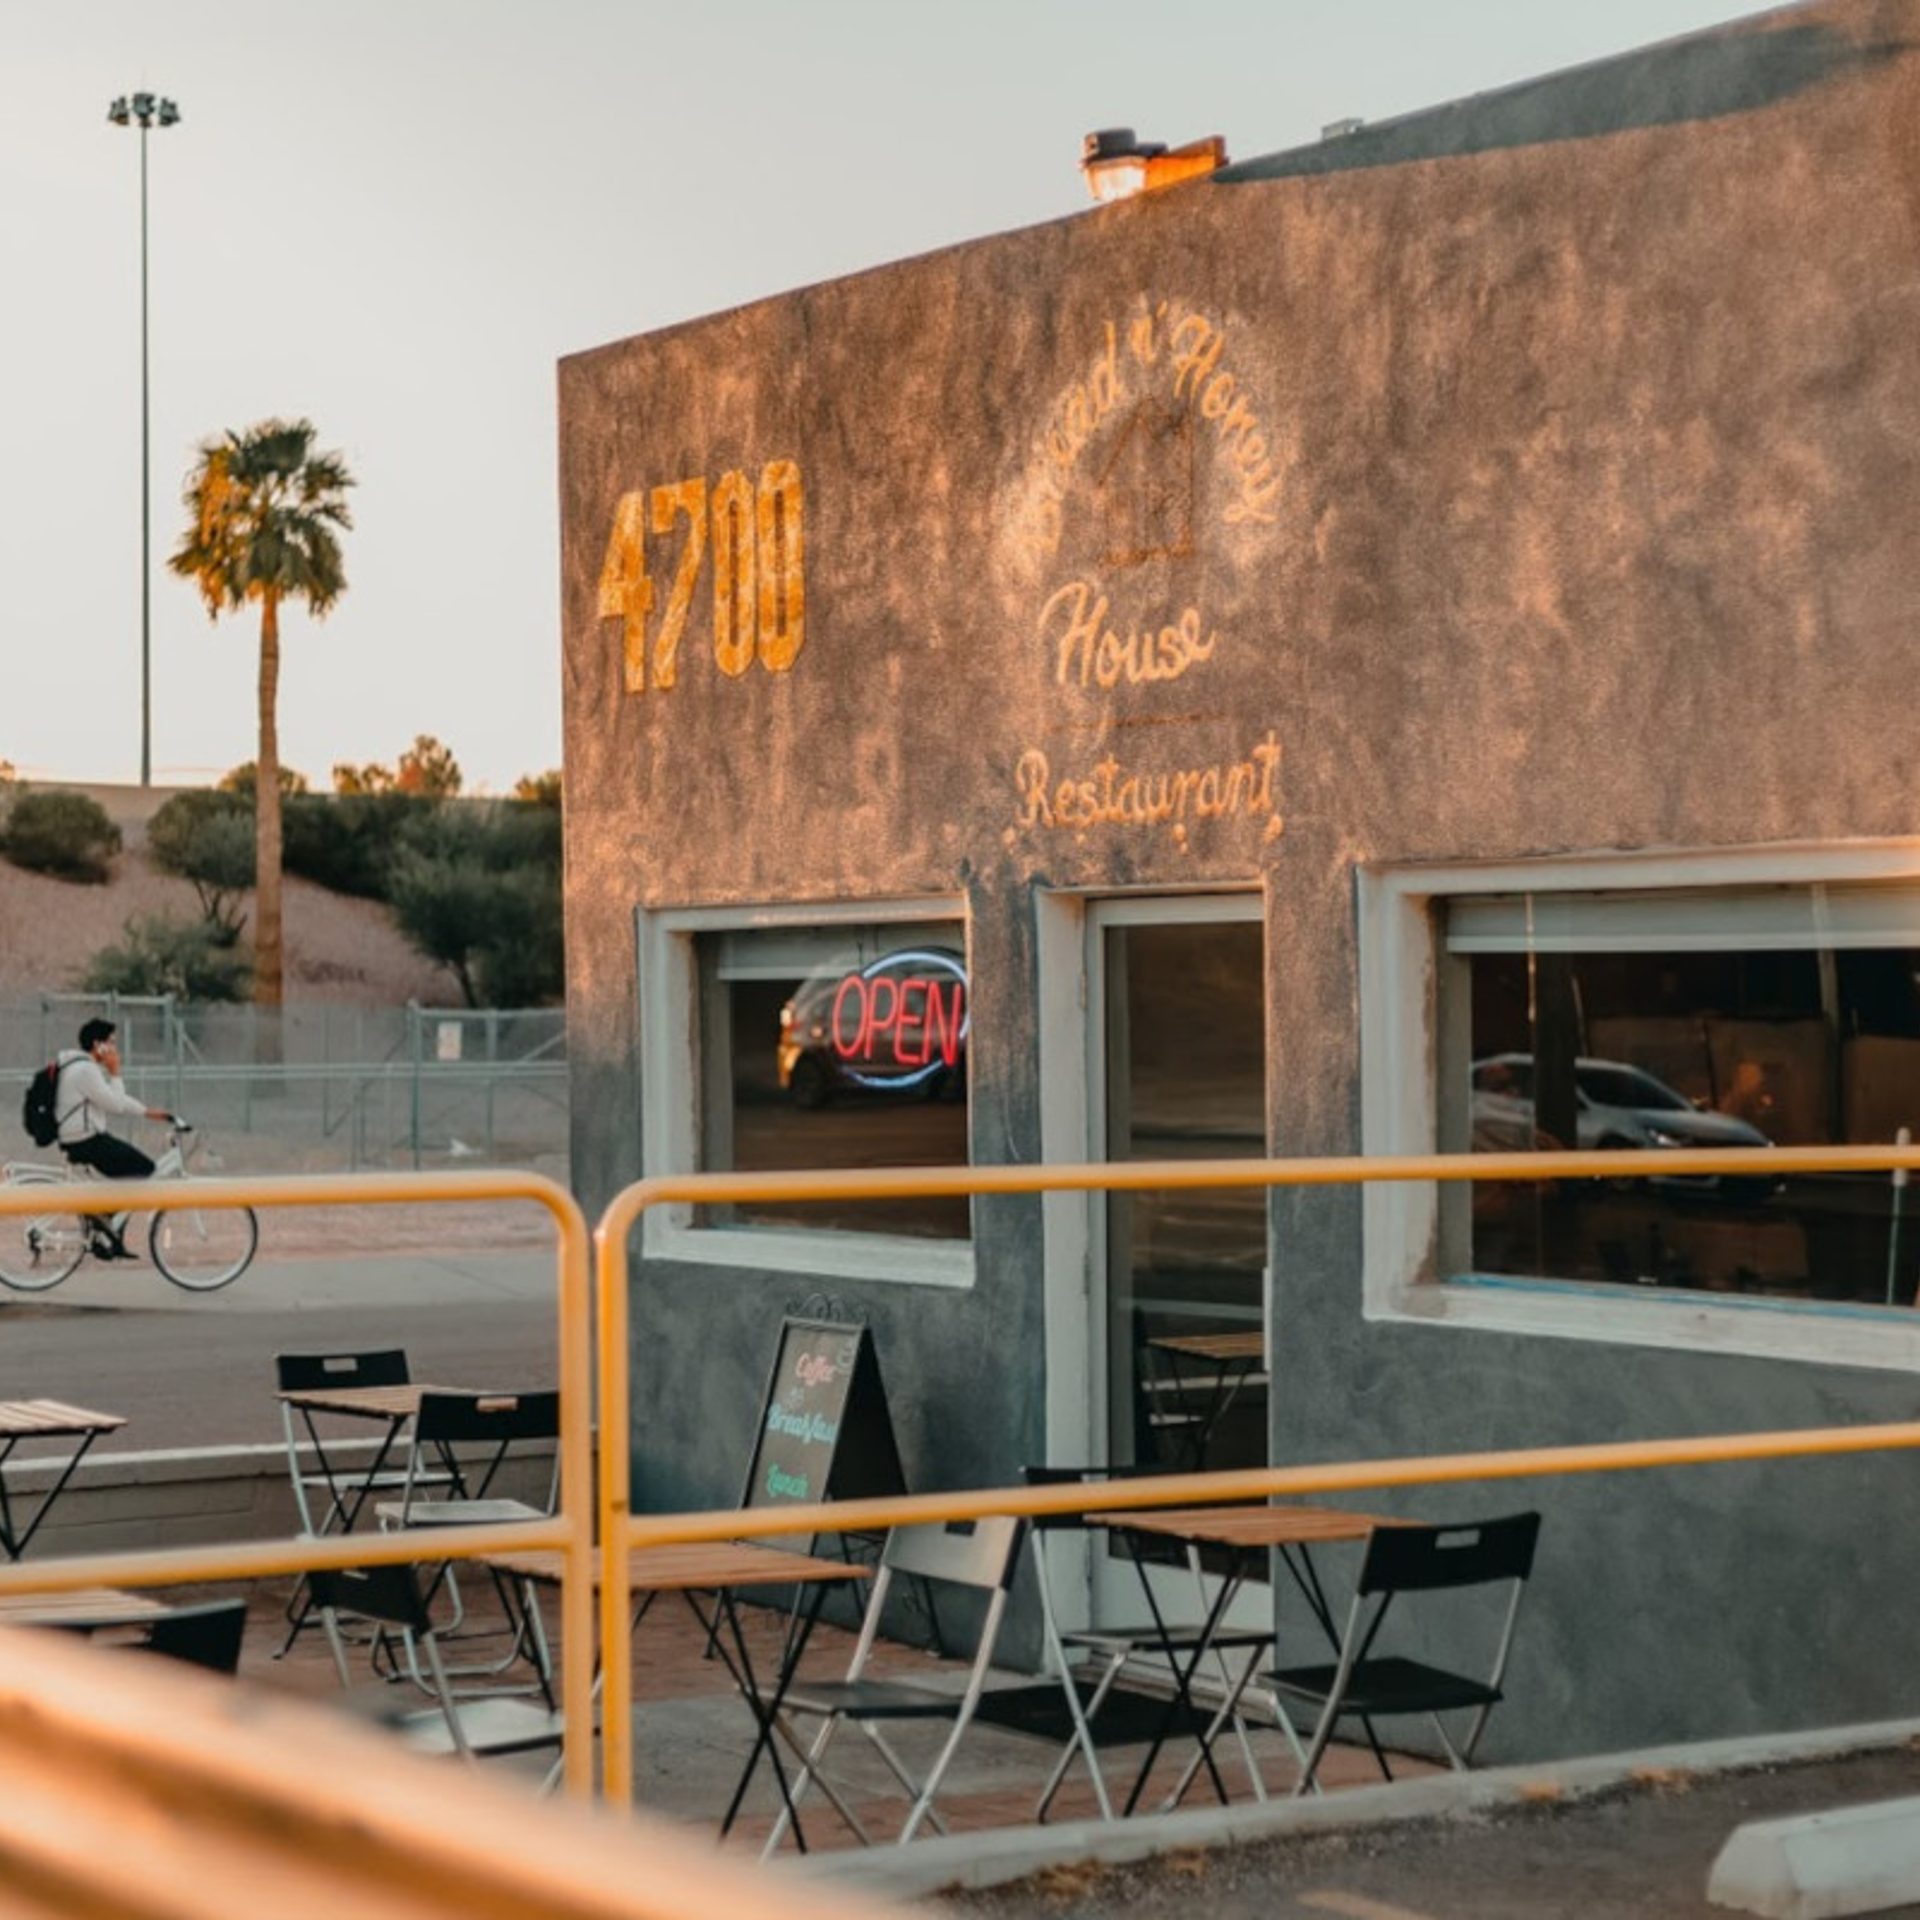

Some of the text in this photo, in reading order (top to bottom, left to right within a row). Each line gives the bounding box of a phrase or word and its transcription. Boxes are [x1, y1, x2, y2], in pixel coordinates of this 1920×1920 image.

[1002, 320, 1122, 572] ead
[598, 459, 805, 693] 4700
[1037, 582, 1216, 689] House
[1015, 730, 1283, 828] Restaurant
[832, 974, 962, 1066] OPEN
